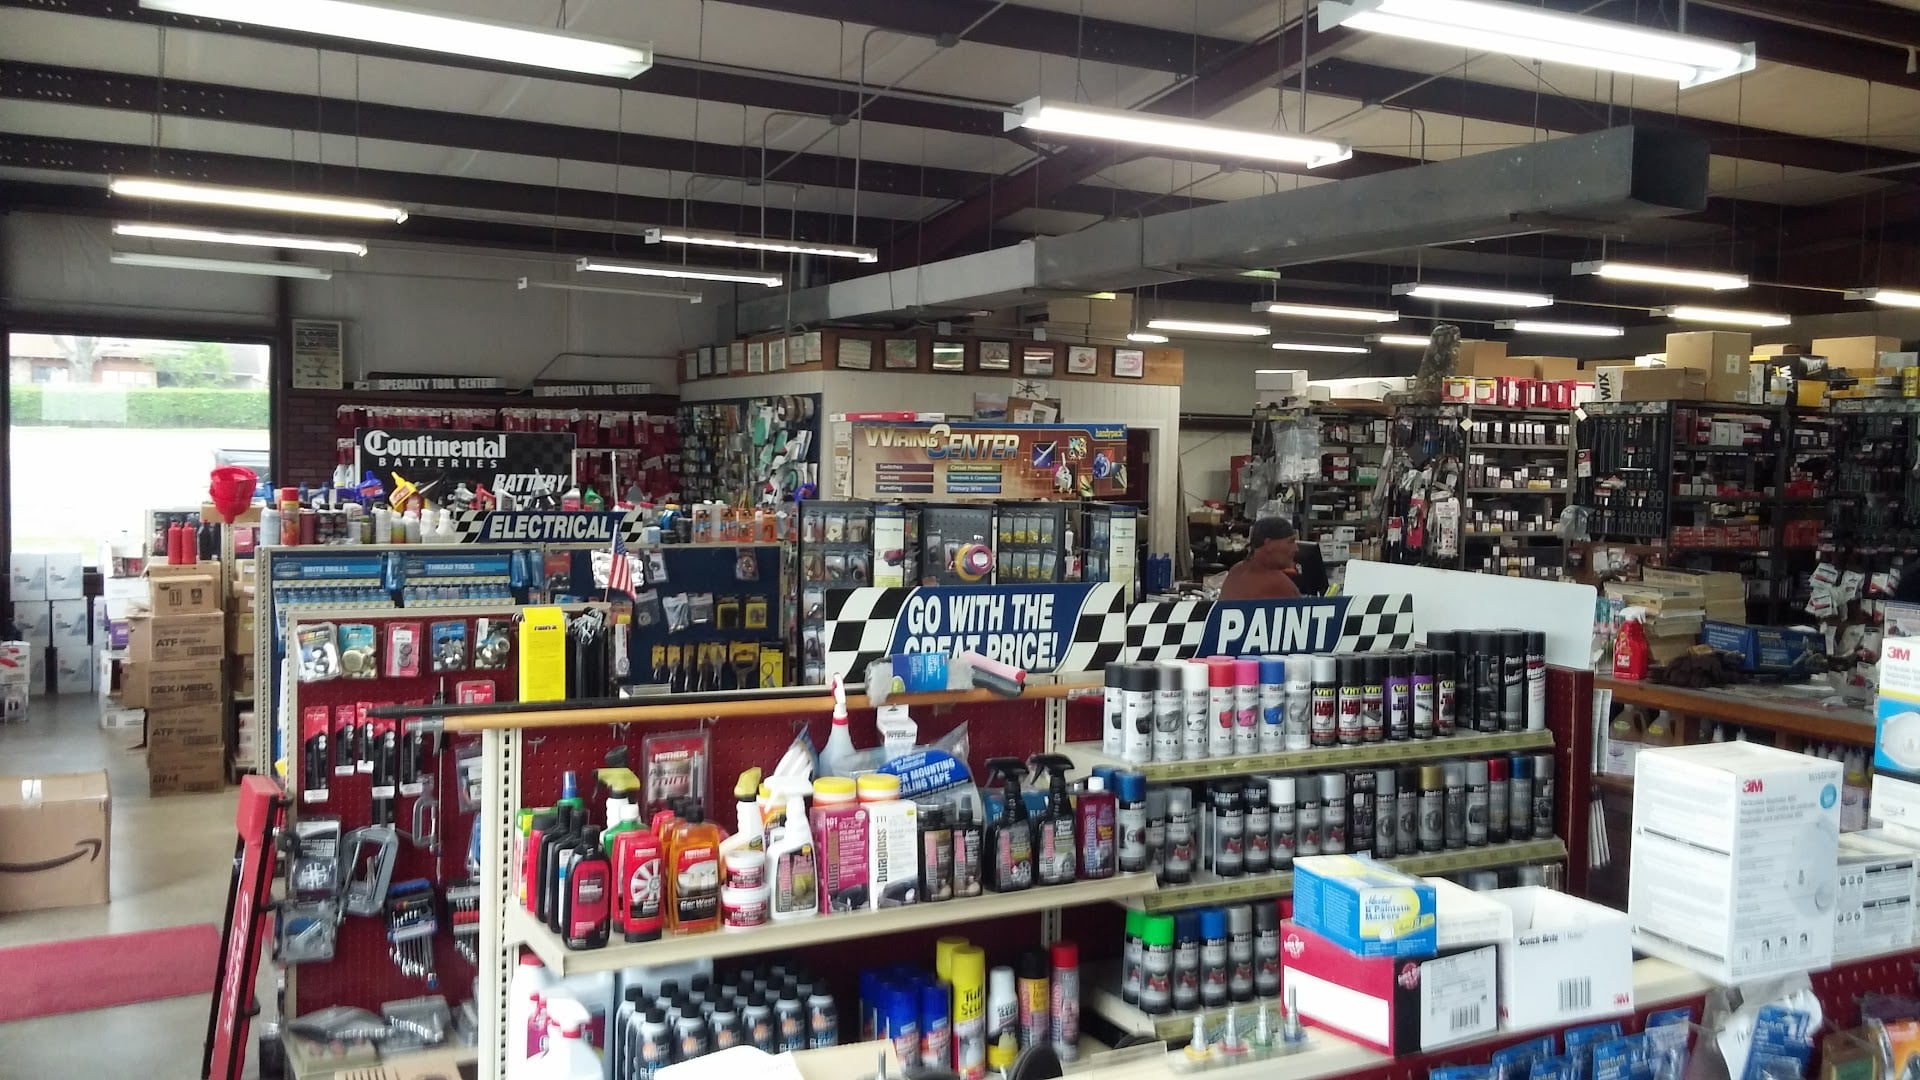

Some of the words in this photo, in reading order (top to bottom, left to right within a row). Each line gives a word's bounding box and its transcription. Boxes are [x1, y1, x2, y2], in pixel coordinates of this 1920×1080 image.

[379, 379, 430, 390] SPECIALTY
[432, 379, 456, 389] TOOL
[459, 378, 496, 389] CENTER
[544, 385, 589, 396] SPECIALTY
[592, 385, 614, 395] TOOL
[617, 384, 650, 394] CENTER
[1598, 373, 1611, 400] WIX
[364, 430, 506, 458] Continental
[927, 423, 1020, 460] CENTER
[379, 457, 498, 469] BATTERIES
[489, 515, 610, 539] ELECTRICAL
[907, 595, 942, 634] GO
[949, 594, 1005, 633] WITH
[1011, 593, 1055, 631] THE
[1217, 605, 1336, 654] PAINT
[156, 638, 178, 647] ATF
[987, 631, 1059, 669] PRICE!
[1887, 646, 1911, 661] 3M
[910, 757, 956, 780] MOUNTING
[928, 771, 951, 788] TAPE
[1742, 779, 1763, 793] 3M
